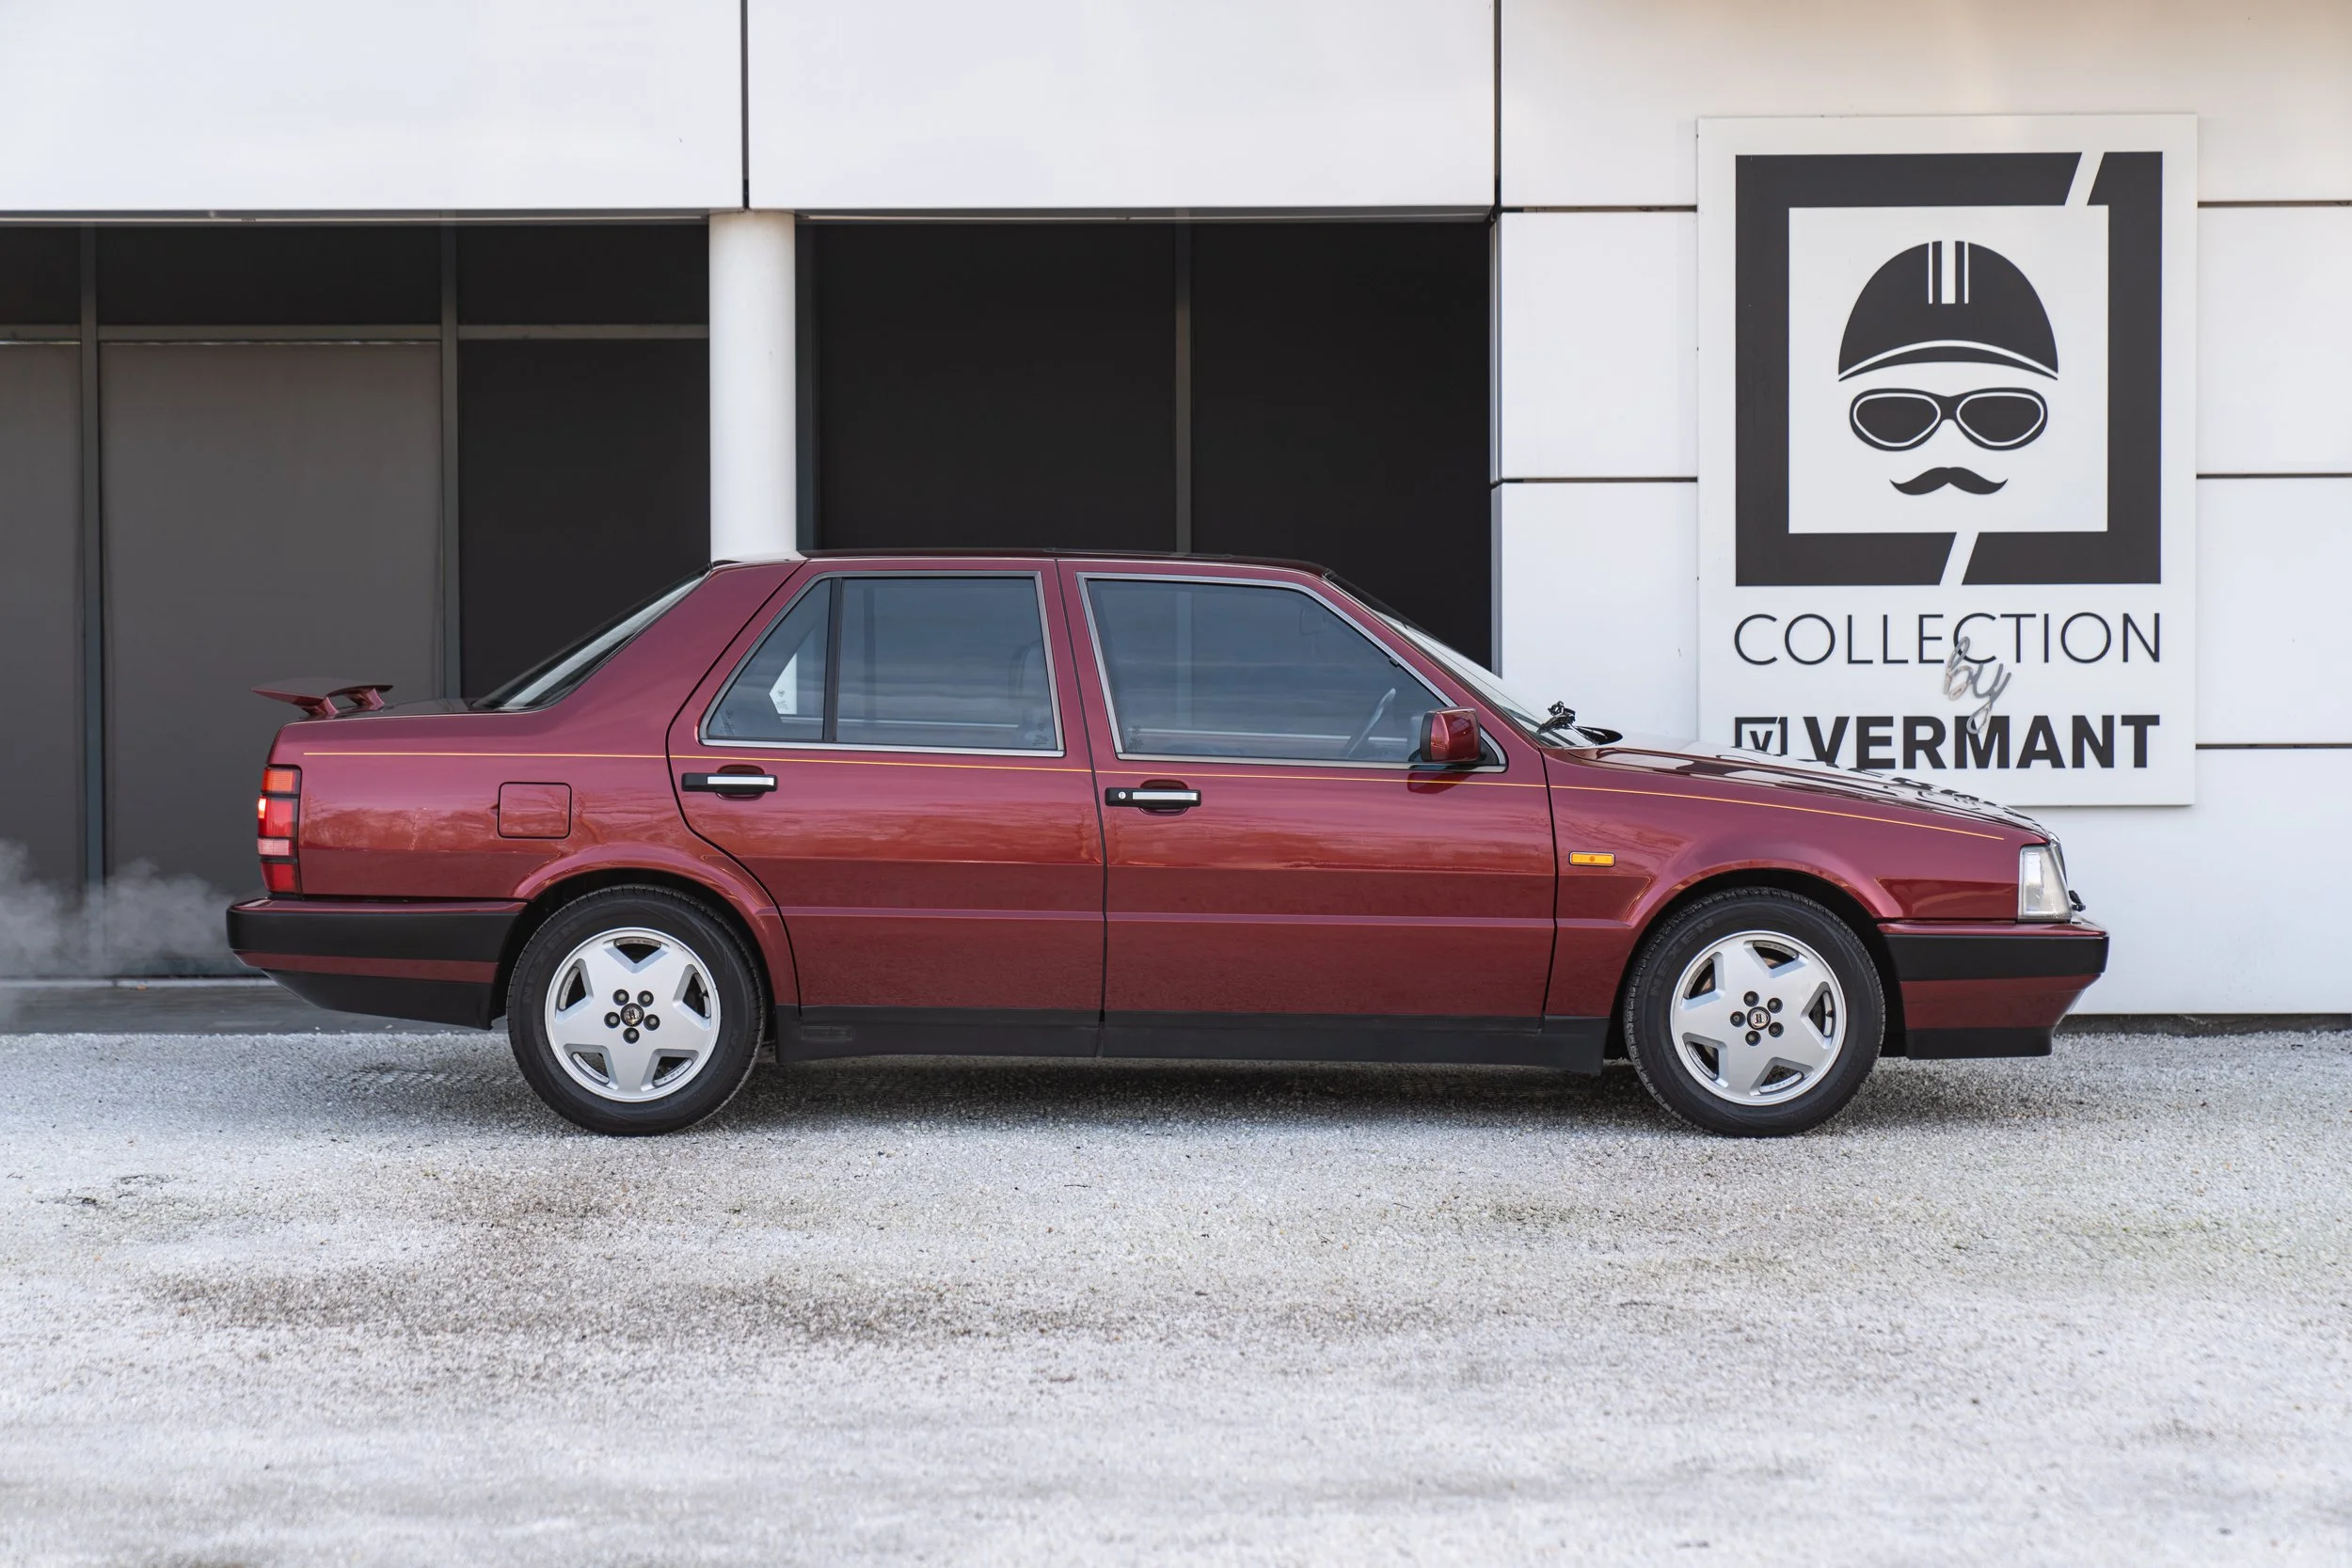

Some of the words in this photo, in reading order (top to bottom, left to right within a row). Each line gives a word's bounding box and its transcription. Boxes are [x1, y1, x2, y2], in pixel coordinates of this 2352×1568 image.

[1734, 612, 2161, 665] COLLECTION
[1943, 636, 2012, 735] by
[1803, 715, 2160, 769] VERMANT
[522, 921, 580, 1005] NEXEN
[1649, 917, 1715, 997] NEXEN
